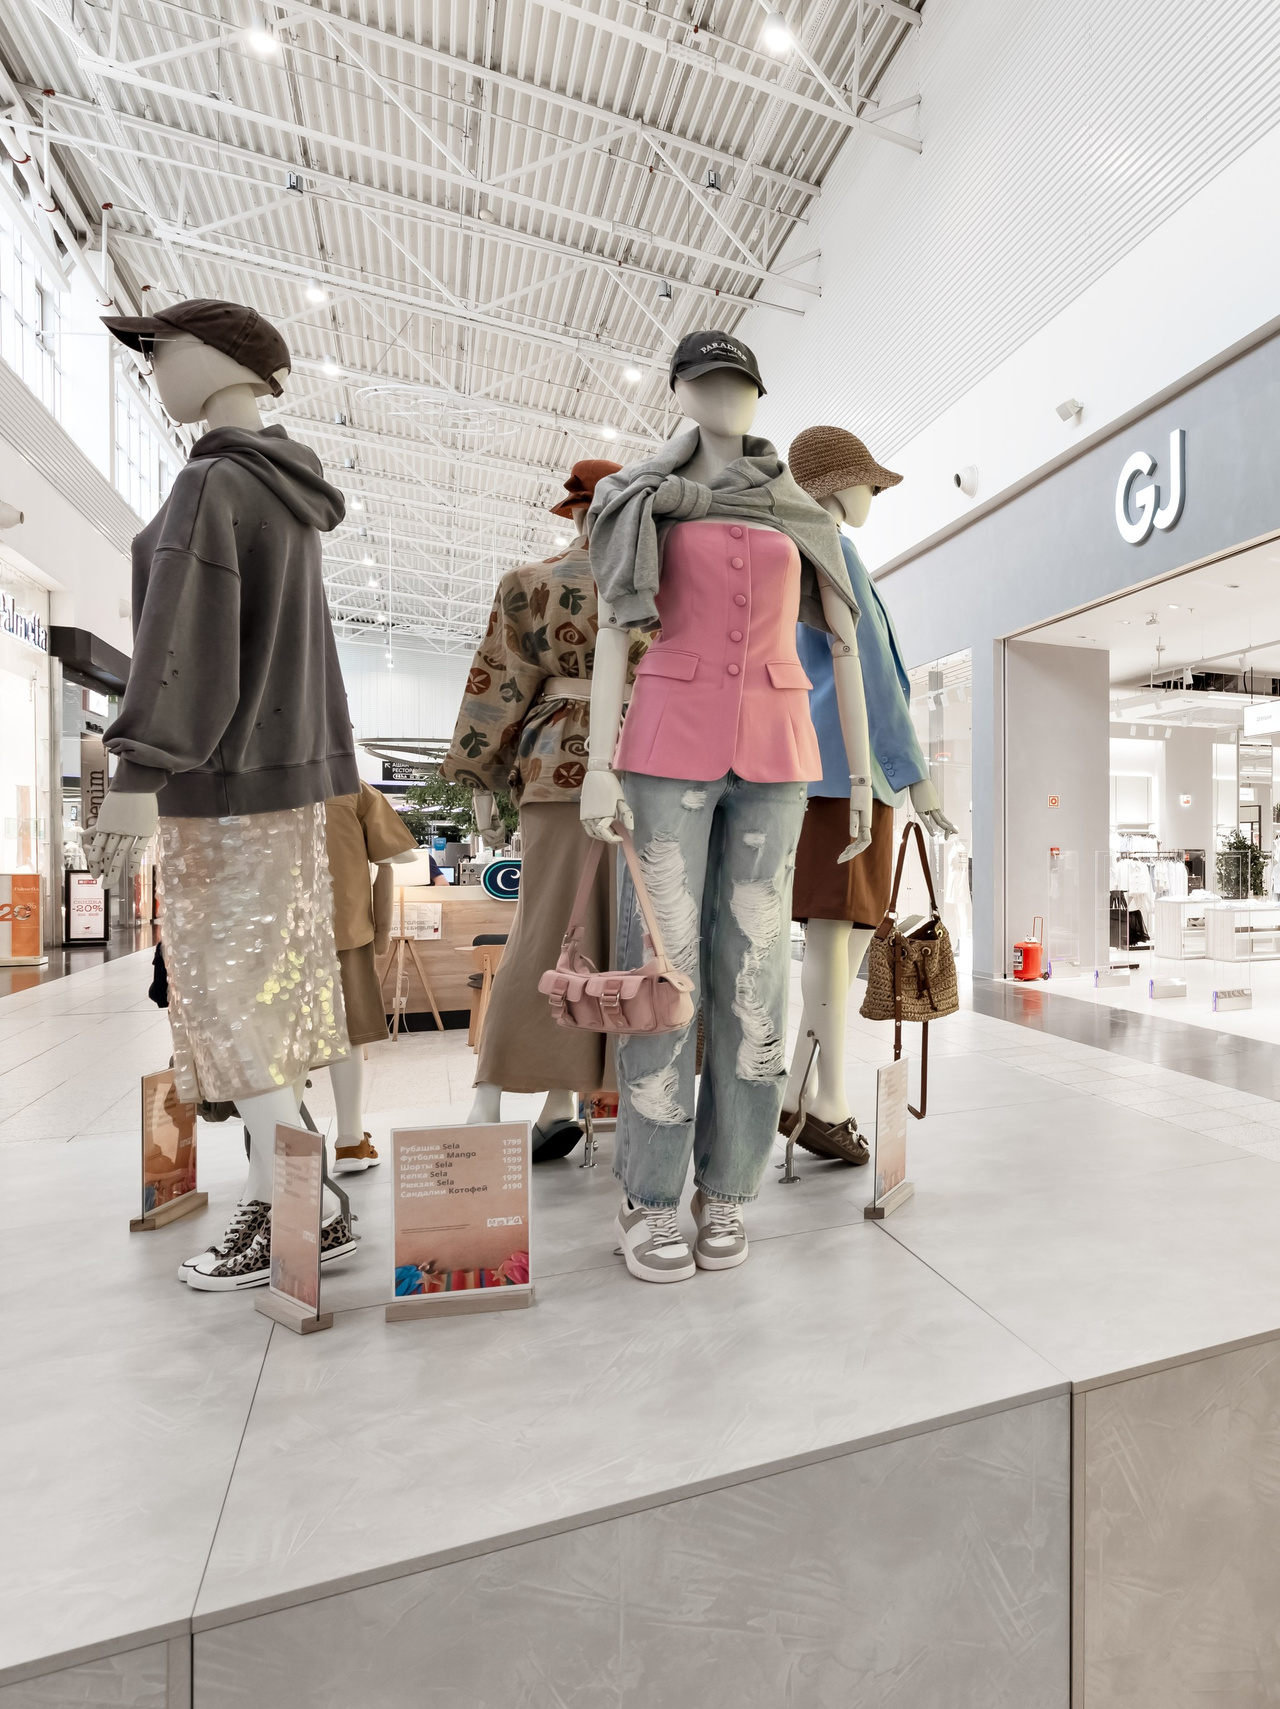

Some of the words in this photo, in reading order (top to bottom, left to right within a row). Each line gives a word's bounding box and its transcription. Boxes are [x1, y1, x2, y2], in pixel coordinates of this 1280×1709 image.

[700, 342, 748, 362] PARADISE
[1115, 428, 1186, 544] GJ
[72, 904, 103, 912] -20%
[442, 1143, 460, 1151] Sela
[448, 1185, 488, 1195] Котофей
